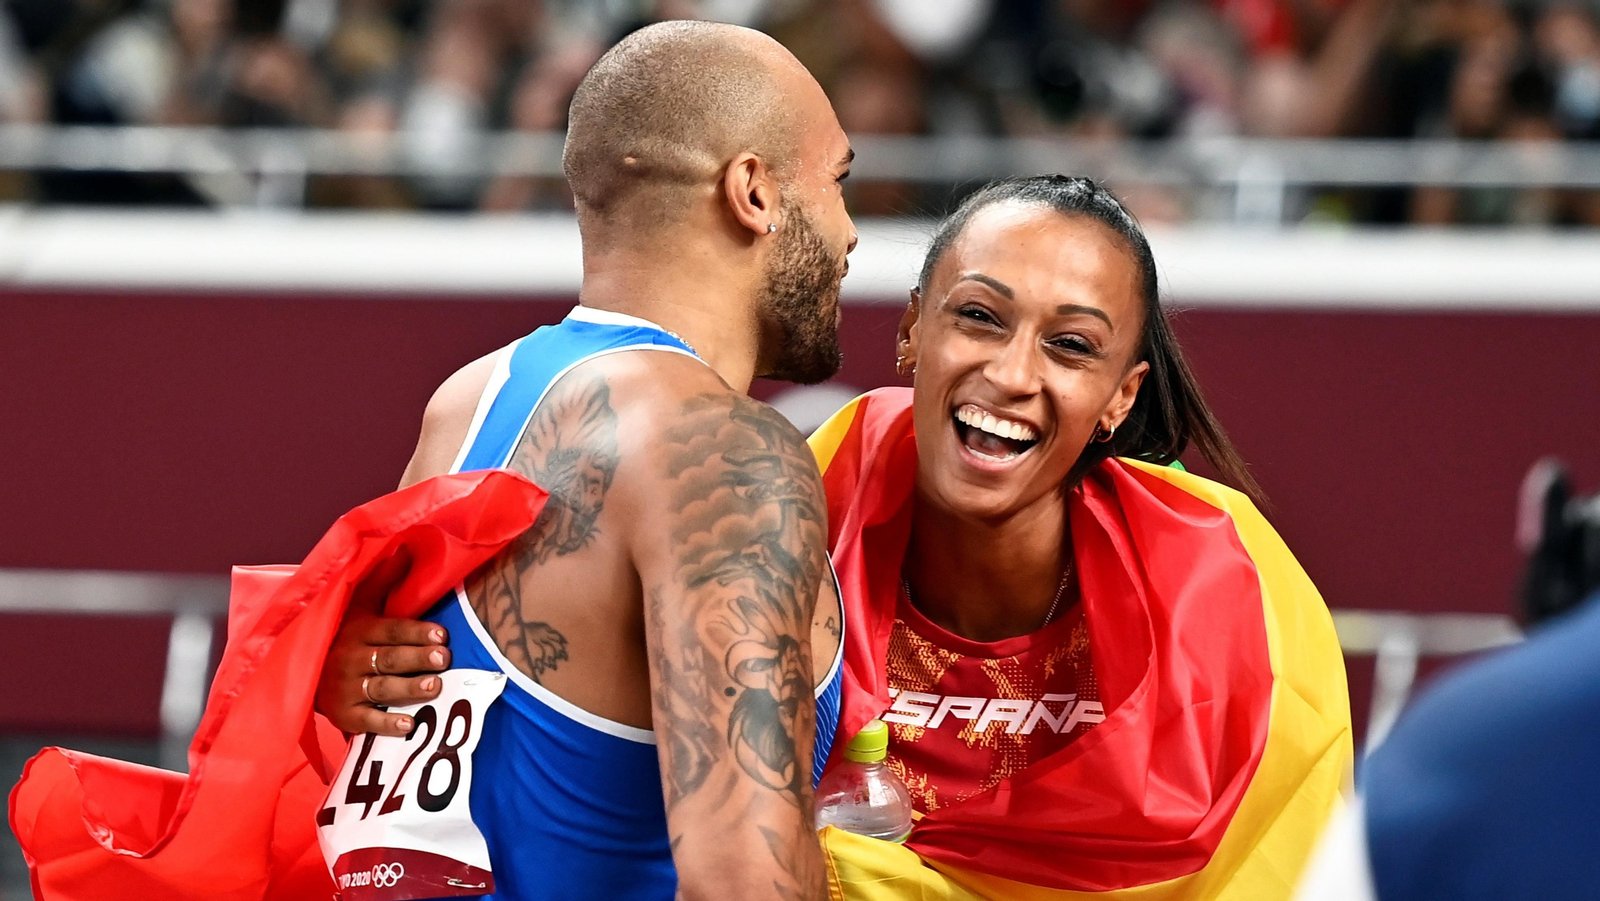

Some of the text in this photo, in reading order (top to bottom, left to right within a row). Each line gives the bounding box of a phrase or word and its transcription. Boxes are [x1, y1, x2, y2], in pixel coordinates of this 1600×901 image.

[876, 688, 1107, 734] SPAÑA
[316, 699, 472, 827] 428
[351, 871, 371, 887] 2020
